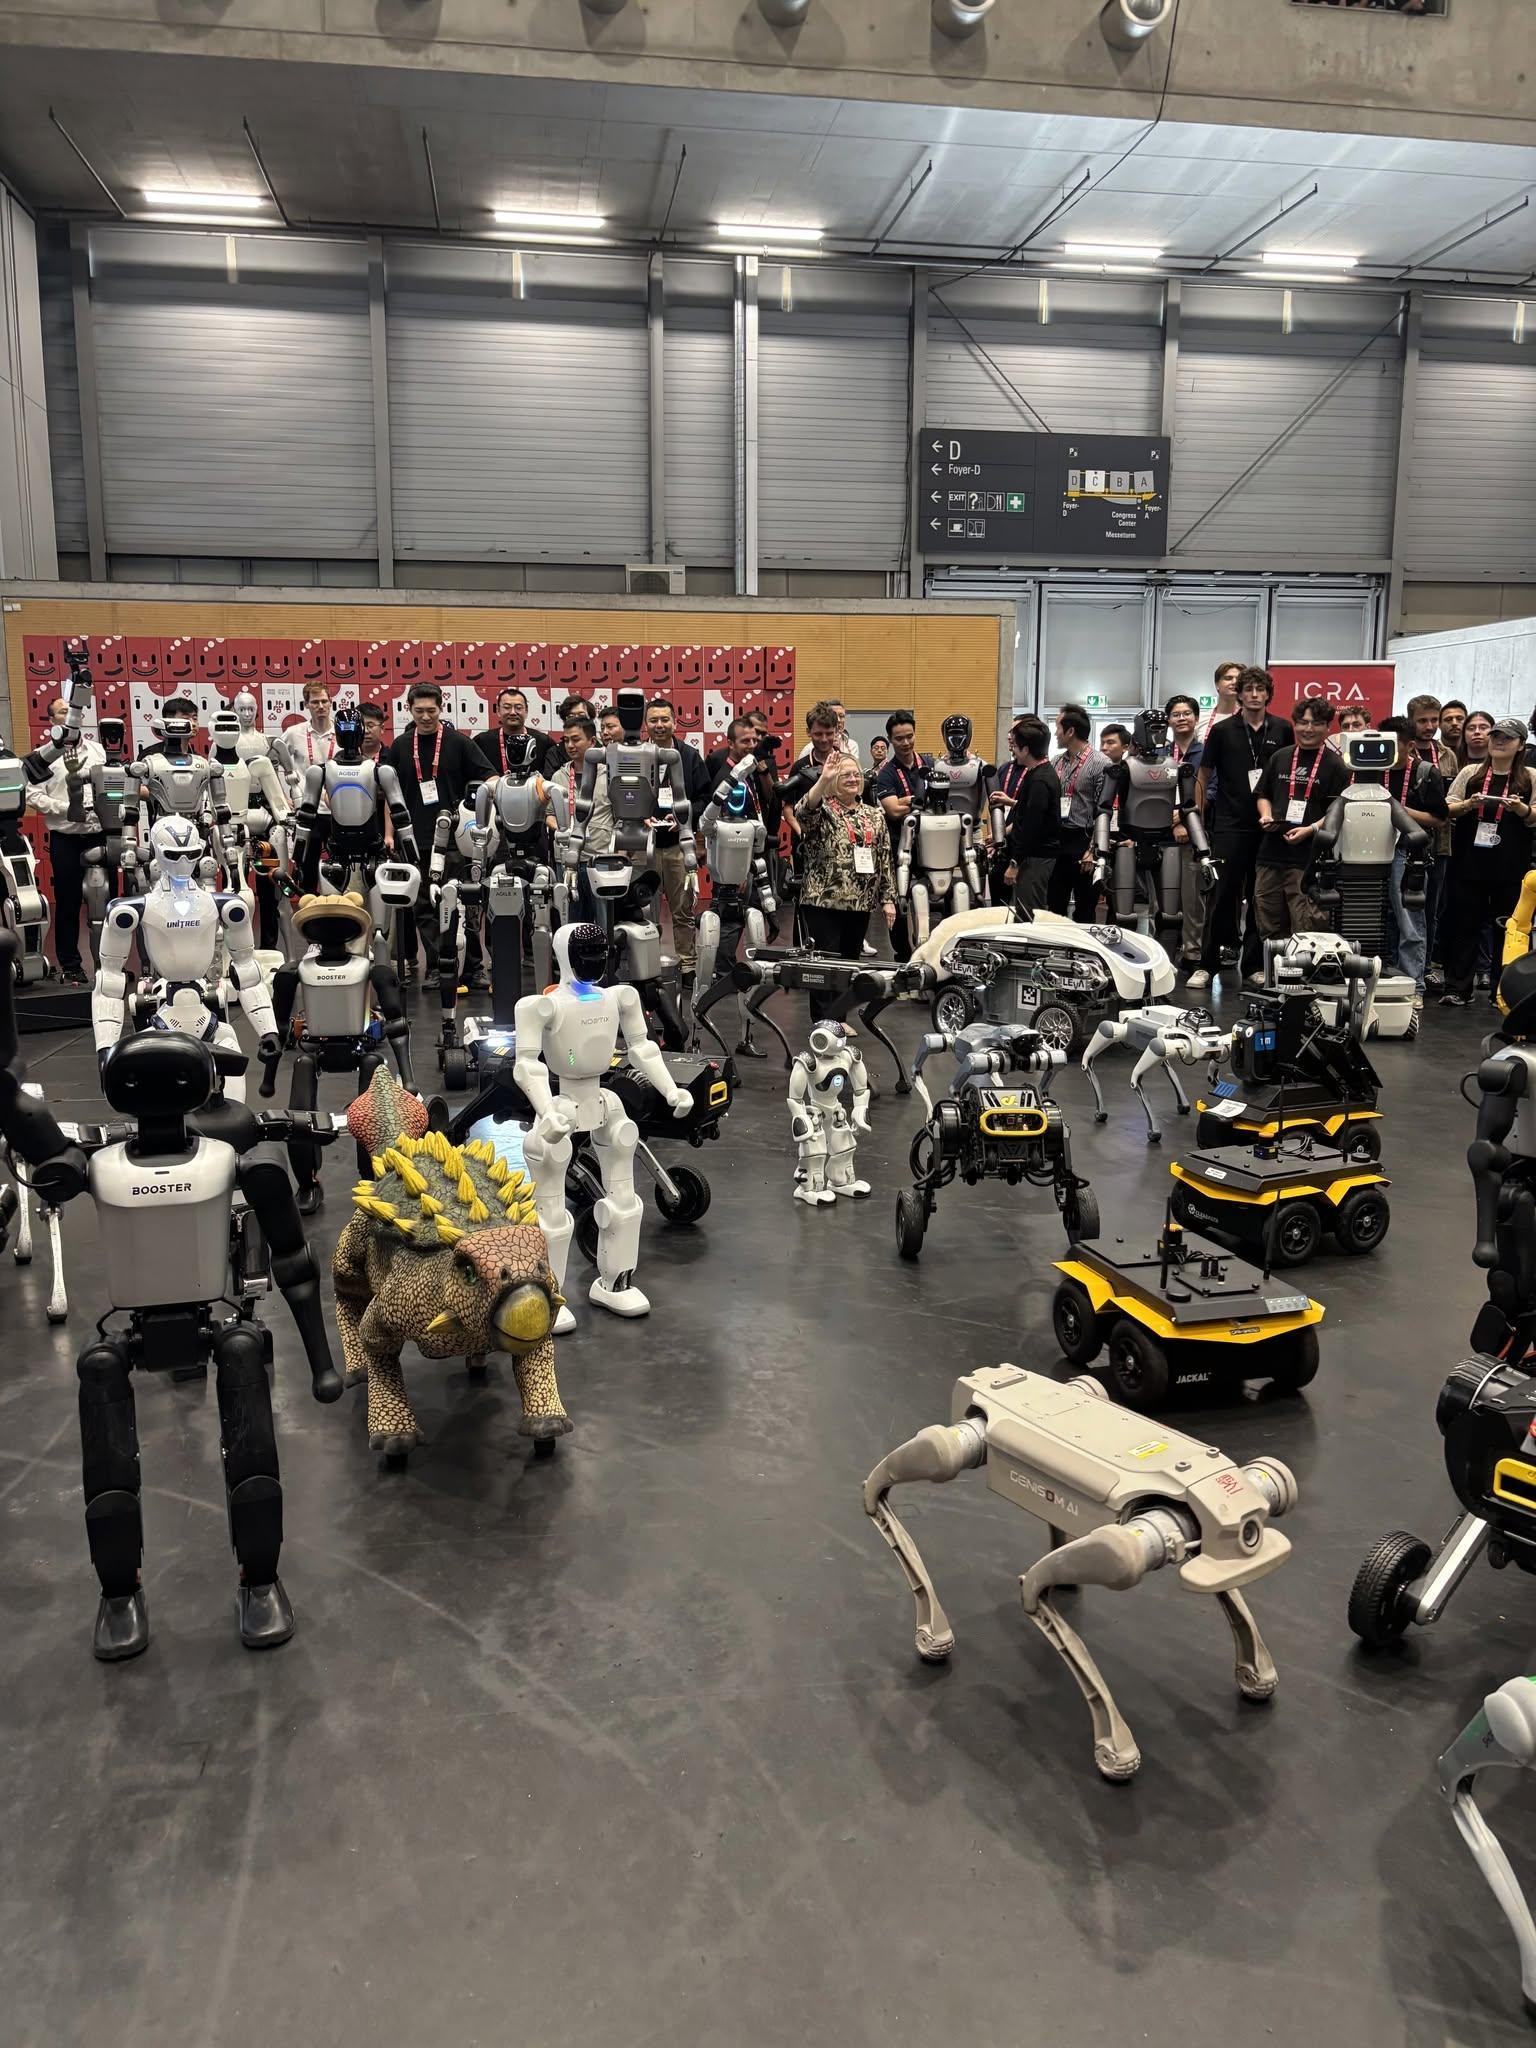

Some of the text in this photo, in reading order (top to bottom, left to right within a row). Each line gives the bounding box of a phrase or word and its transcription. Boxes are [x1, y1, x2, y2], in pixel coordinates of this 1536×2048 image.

[949, 440, 961, 461] D
[948, 463, 981, 476] Foyer-D
[1071, 475, 1078, 486] D
[1092, 476, 1099, 487] C
[1116, 477, 1123, 488] B
[1140, 476, 1148, 488] A
[948, 493, 966, 501] EXIT
[1111, 511, 1137, 520] Congress
[1118, 519, 1137, 528] Center
[1105, 530, 1137, 539] Messeturm
[1294, 681, 1365, 701] ICRA
[132, 1183, 192, 1196] BOOSTER
[1176, 1373, 1209, 1384] JACKAL
[1009, 1470, 1079, 1517] GENISOM AI
